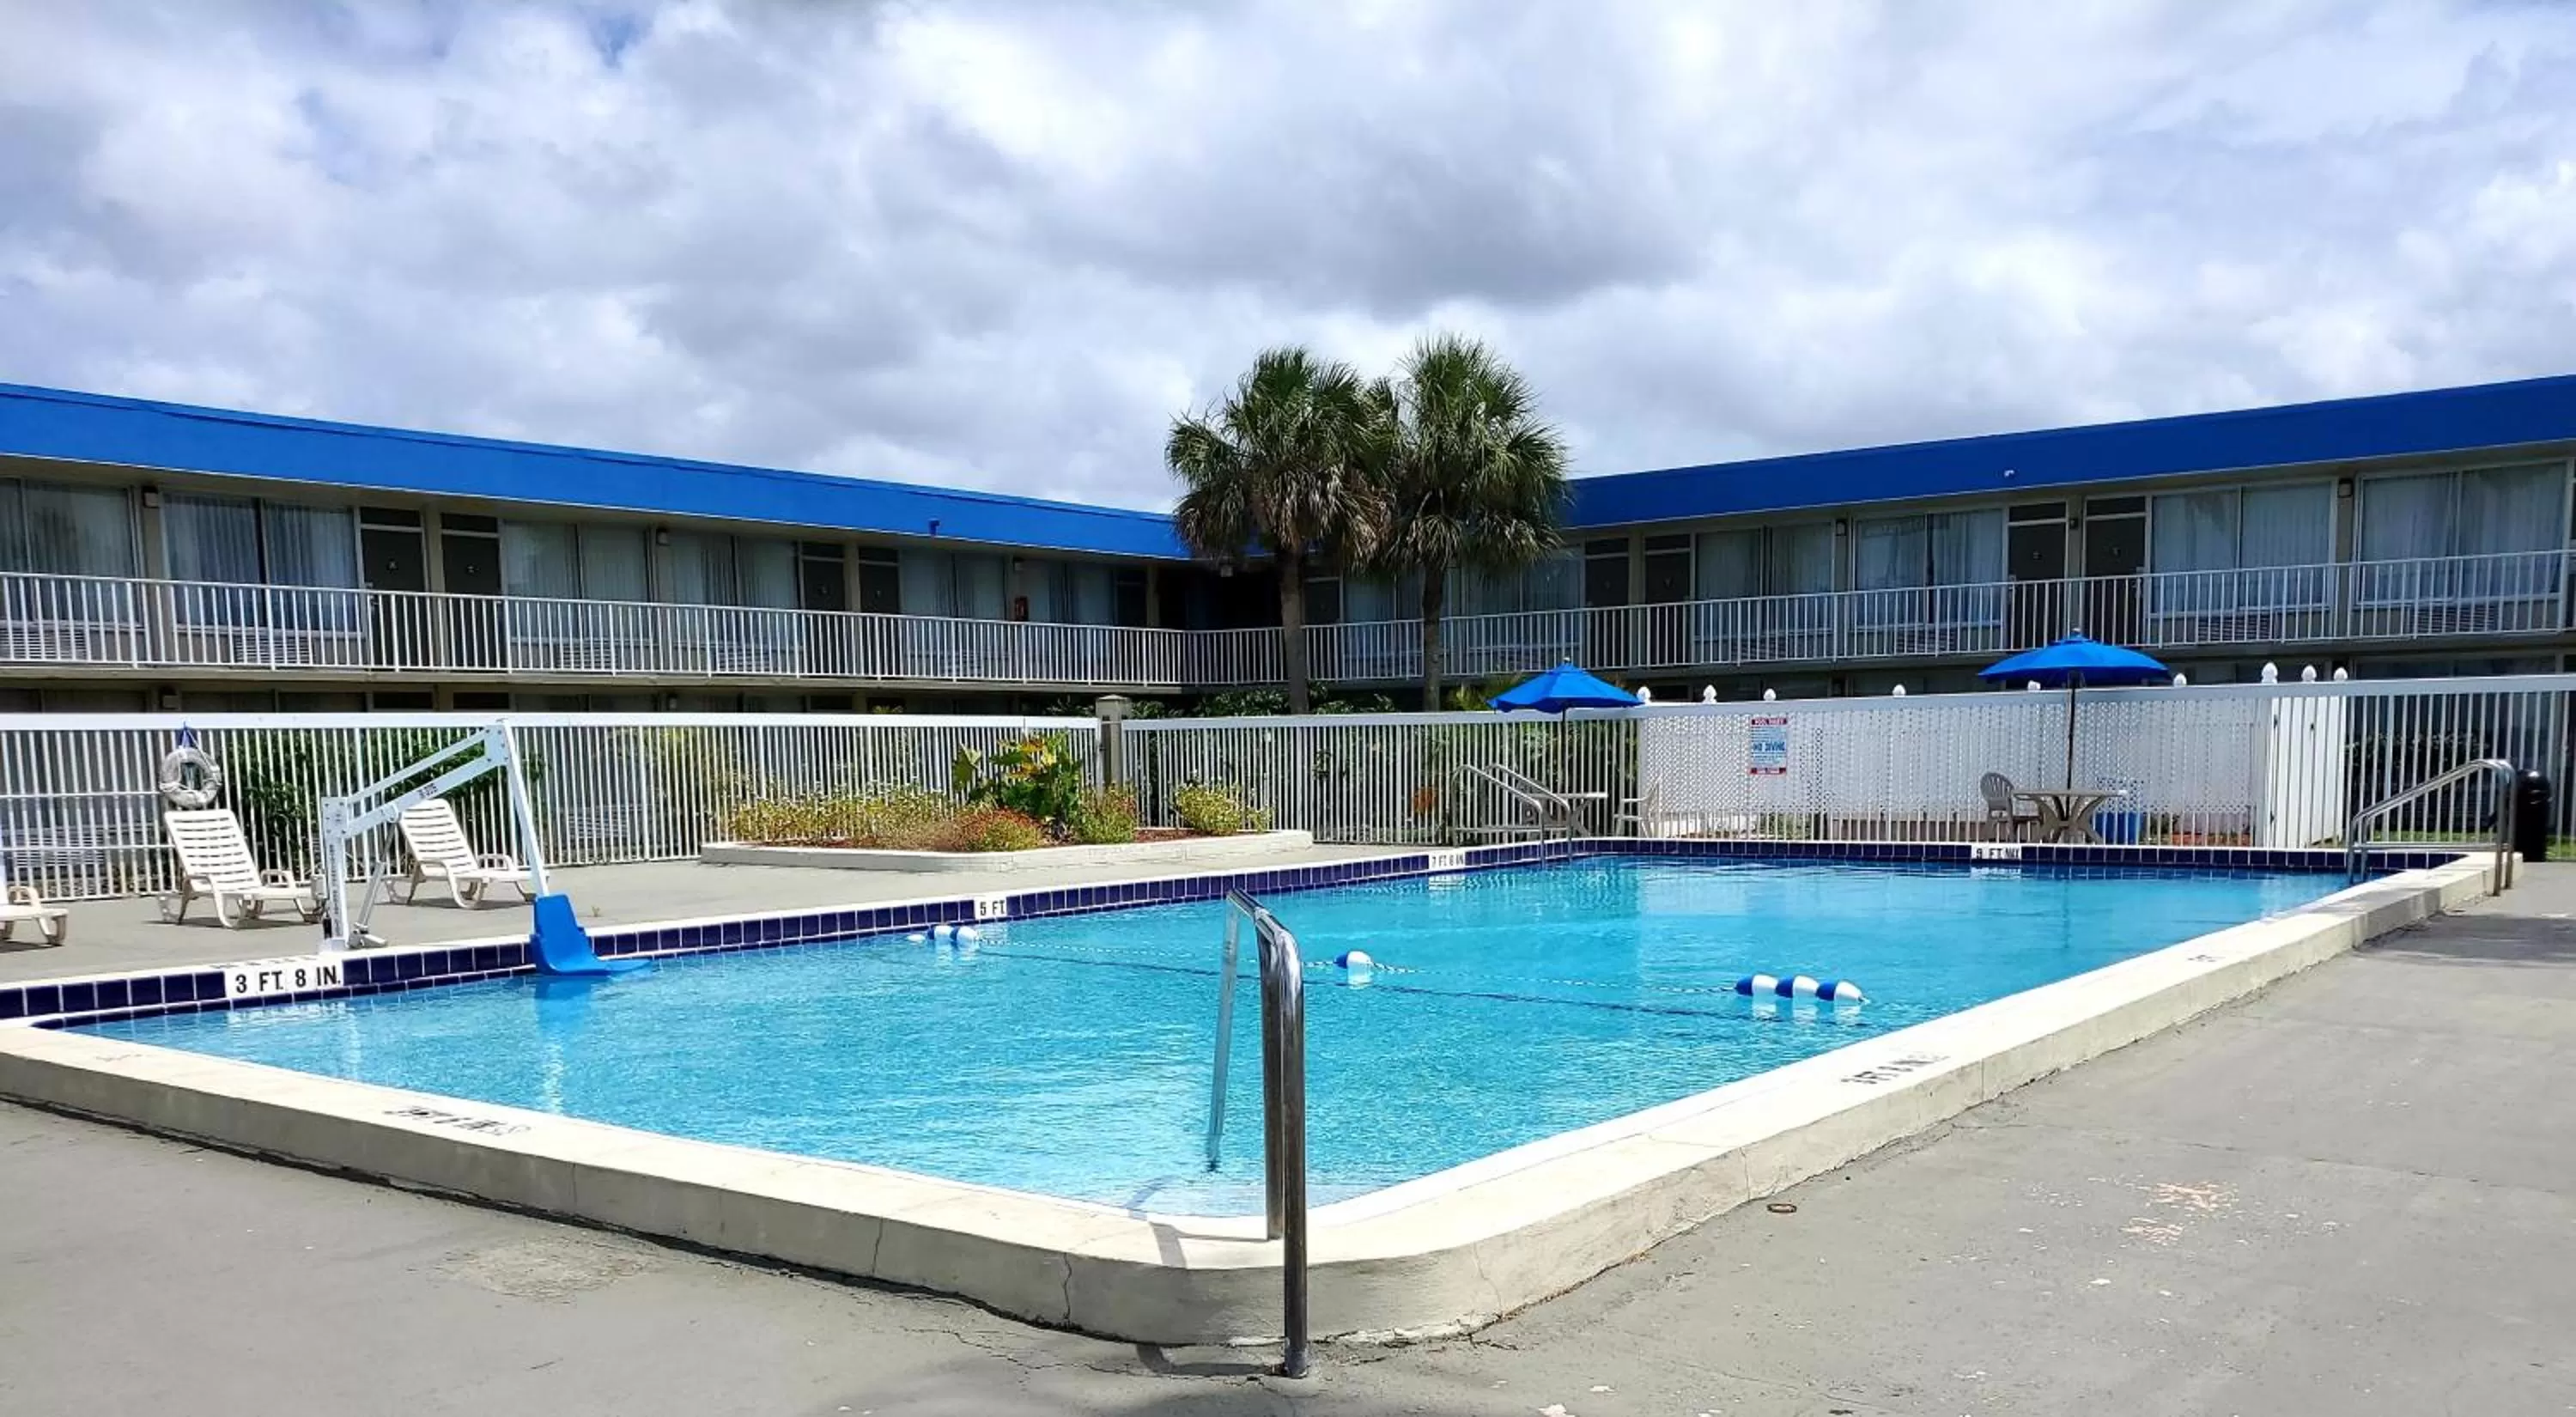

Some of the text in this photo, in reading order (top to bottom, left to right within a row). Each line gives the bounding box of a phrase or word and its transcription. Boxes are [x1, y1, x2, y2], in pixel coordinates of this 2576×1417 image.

[980, 901, 987, 916] 5
[235, 973, 247, 994] 3
[295, 968, 307, 988] 8
[316, 964, 342, 987] IN.
